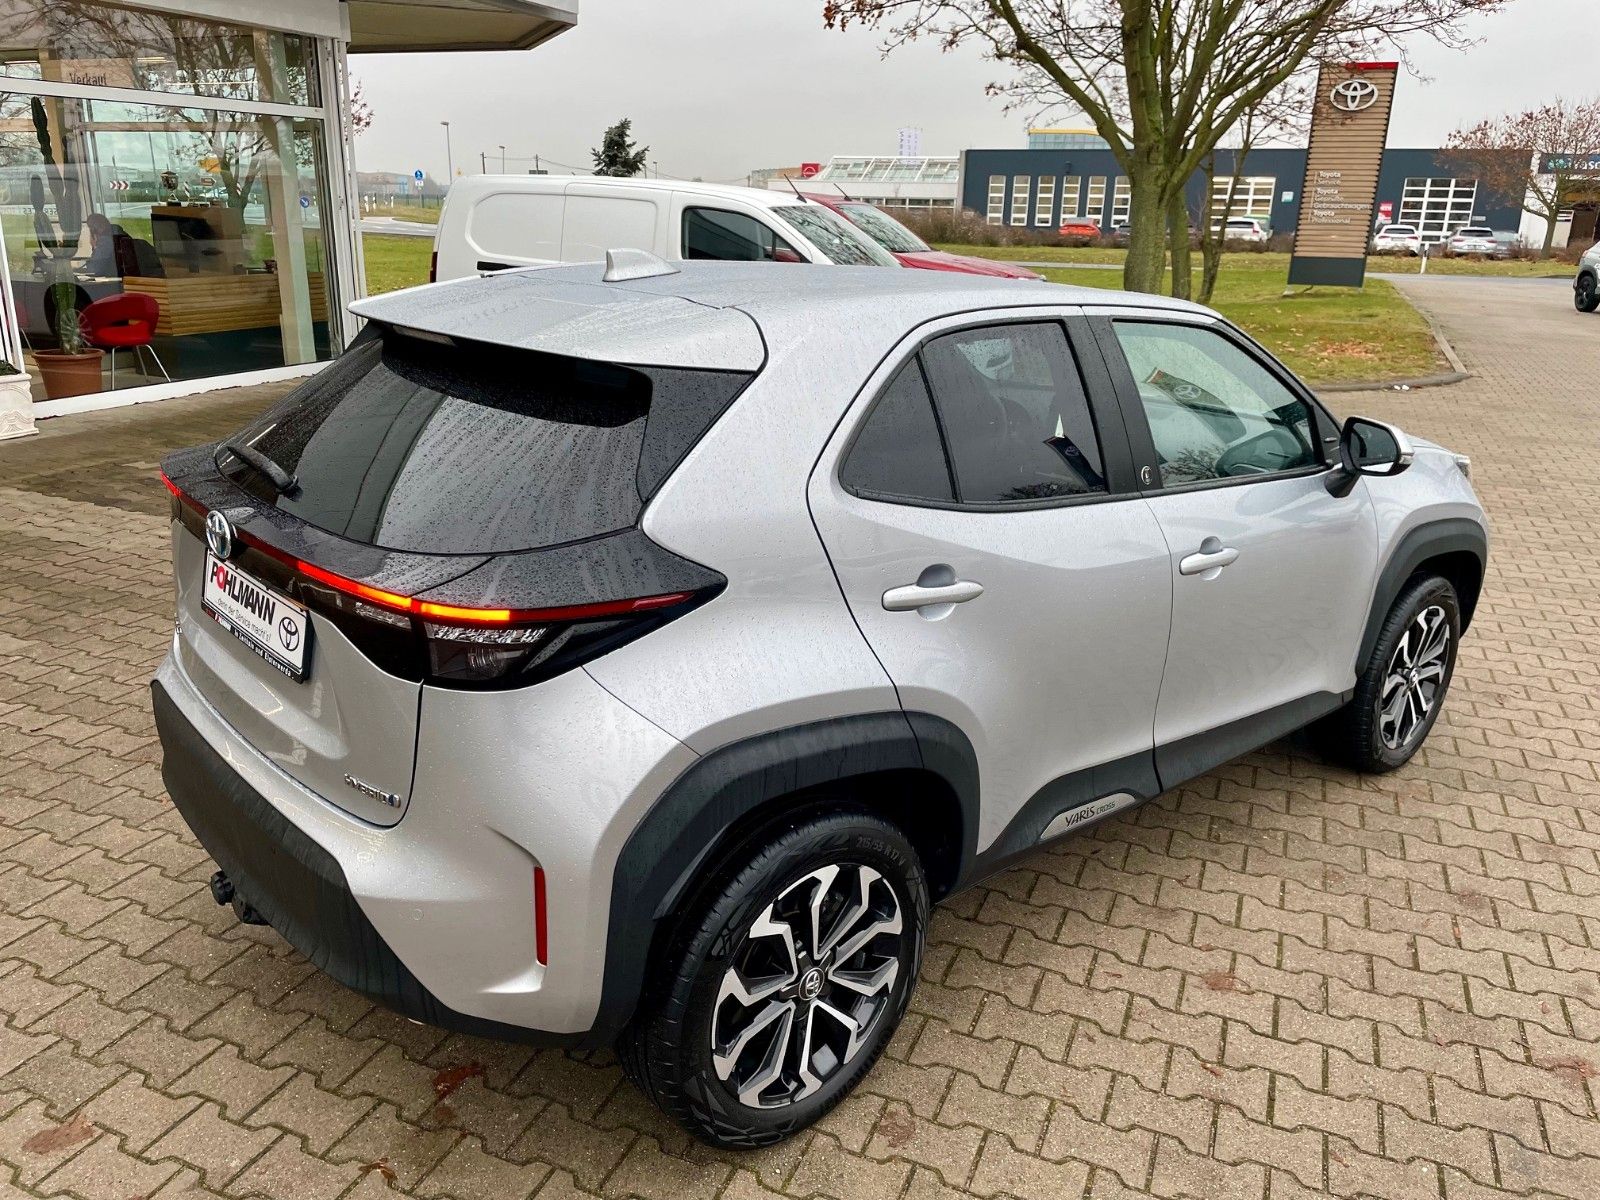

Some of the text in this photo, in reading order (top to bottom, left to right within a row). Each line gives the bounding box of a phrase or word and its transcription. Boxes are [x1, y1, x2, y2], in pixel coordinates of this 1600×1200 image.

[69, 72, 107, 86] Verkauf
[1316, 187, 1339, 195] Toyota
[210, 560, 276, 625] POHLMANN
